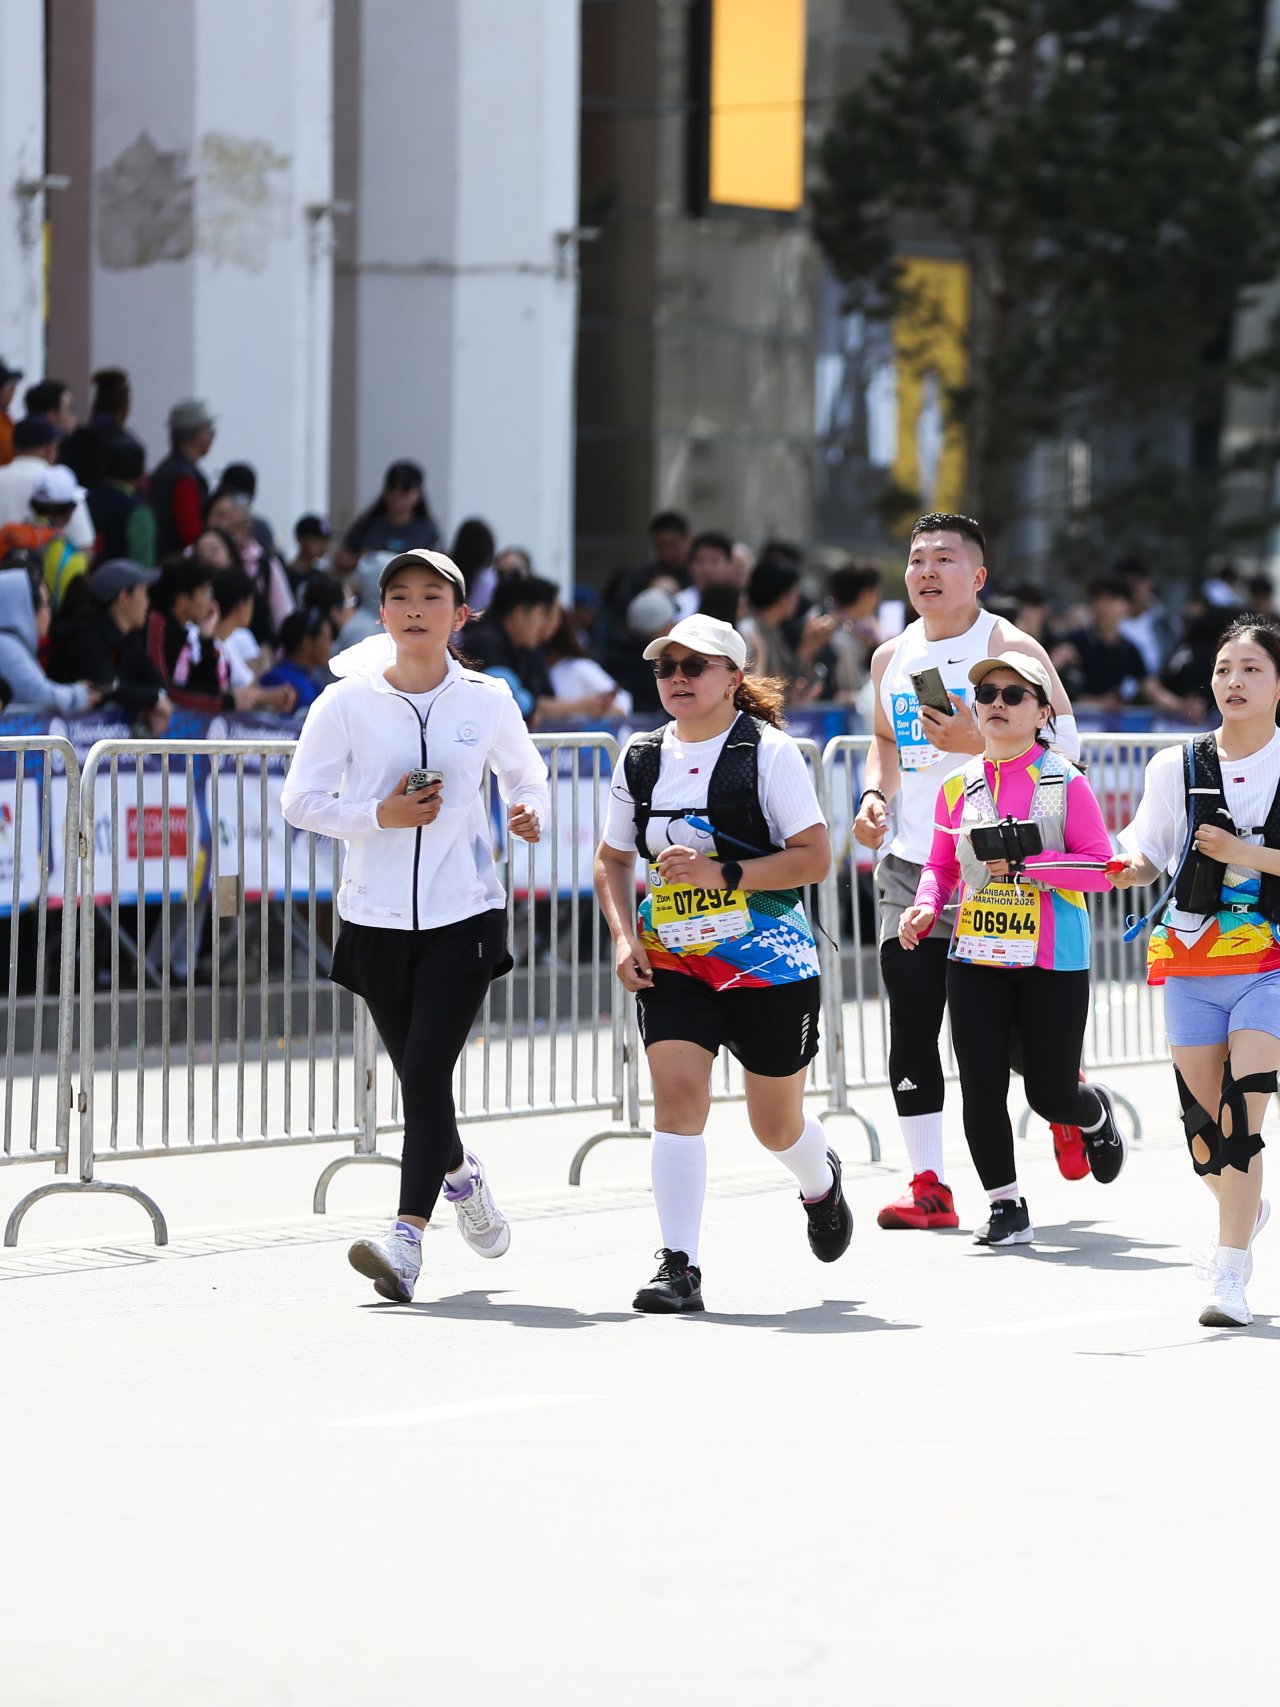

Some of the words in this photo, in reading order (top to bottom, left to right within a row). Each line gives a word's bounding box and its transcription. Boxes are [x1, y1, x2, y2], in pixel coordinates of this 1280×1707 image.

[673, 887, 737, 916] 07292
[973, 895, 1013, 906] MARATHON
[1014, 897, 1036, 907] 2026
[973, 909, 1036, 935] 06944
